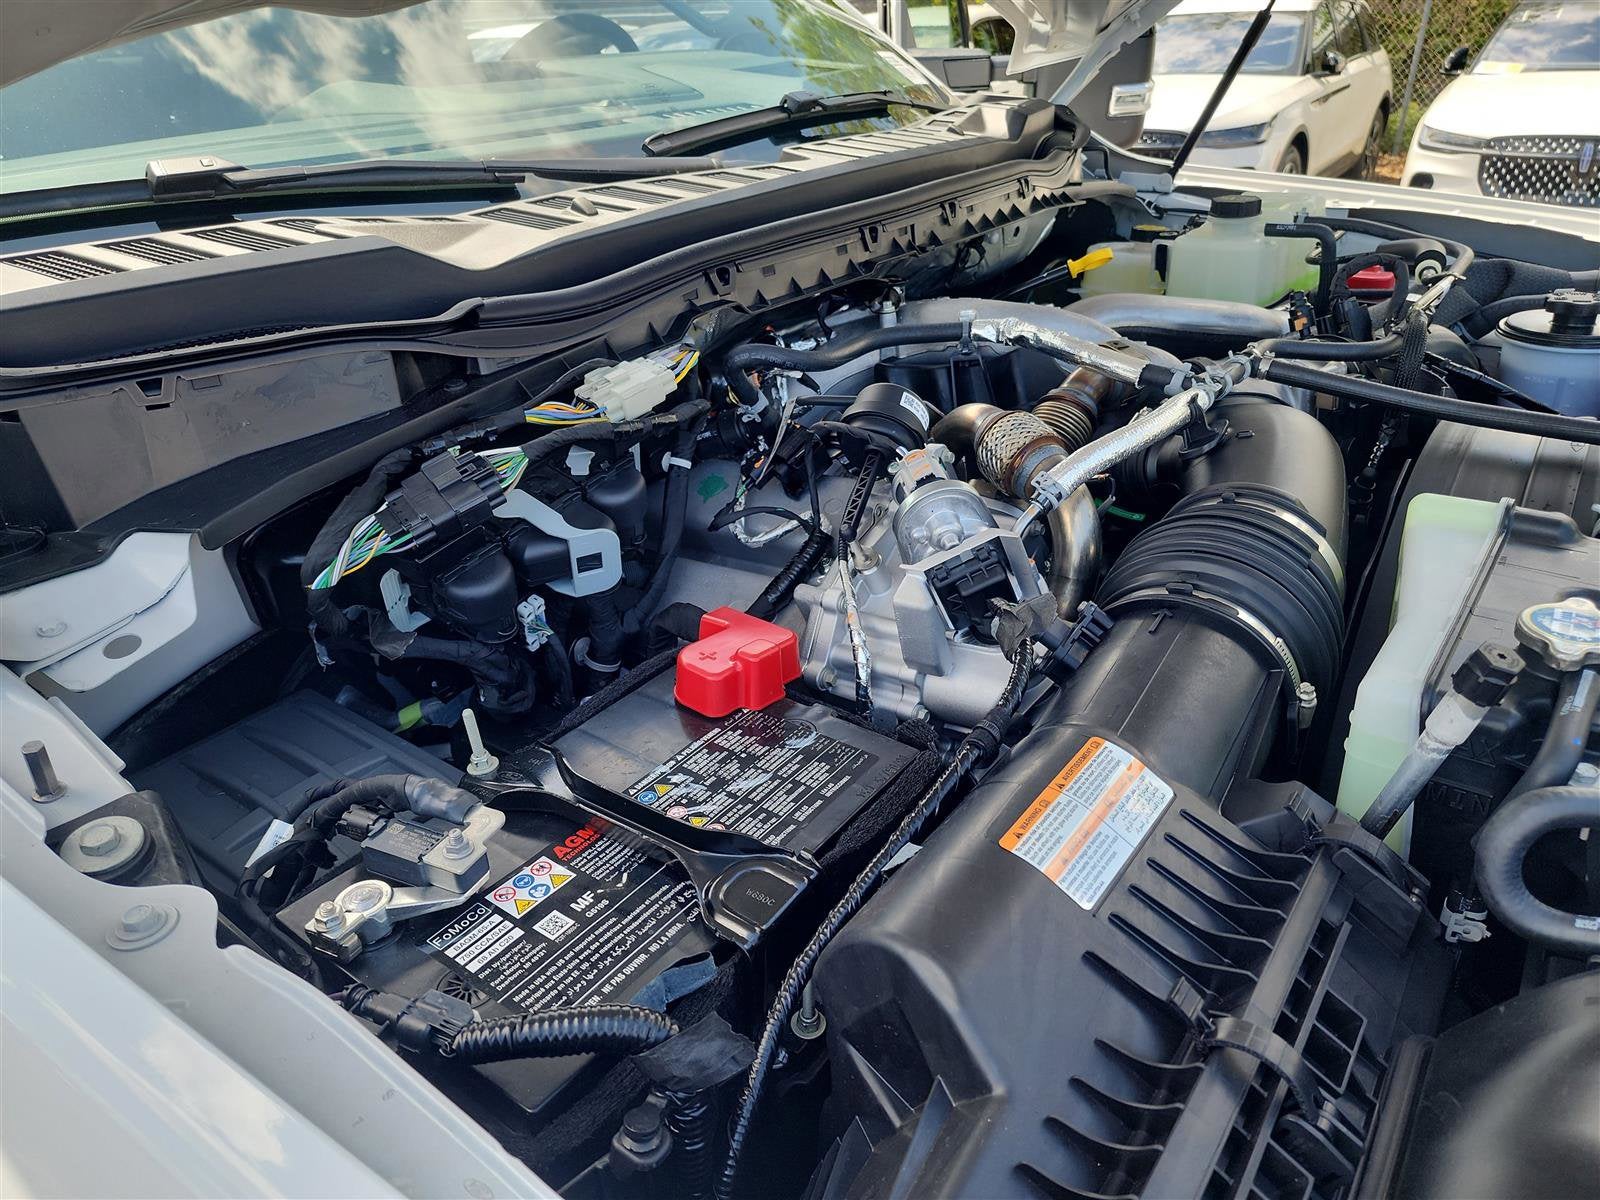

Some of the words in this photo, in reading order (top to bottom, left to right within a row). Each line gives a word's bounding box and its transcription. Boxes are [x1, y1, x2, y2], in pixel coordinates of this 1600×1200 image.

[1061, 747, 1093, 781] AVERTISSEMENT
[1019, 806, 1042, 830] WARNING
[568, 889, 595, 912] MF
[431, 905, 487, 947] FoMoCo
[452, 918, 495, 952] BAGM-65-A
[458, 948, 476, 962] 750
[473, 922, 510, 951] CCA/SAE
[486, 945, 499, 957] Ah
[497, 934, 514, 948] C20
[599, 981, 614, 996] NE
[609, 970, 626, 988] PAS
[621, 949, 651, 977] OUVRIR.
[646, 940, 660, 954] NO
[655, 933, 669, 947] LA
[664, 918, 686, 939] ABRA.
[489, 973, 505, 987] Ford
[502, 960, 521, 976] Motor
[518, 939, 547, 964] Company,
[495, 966, 525, 992] Dearborn,
[511, 987, 530, 1003] Made
[532, 973, 547, 986] USA
[542, 963, 559, 977] with
[562, 949, 575, 961] and
[569, 967, 582, 978] EE.
[578, 958, 592, 971] UU.
[519, 985, 547, 1009] Fabriqué
